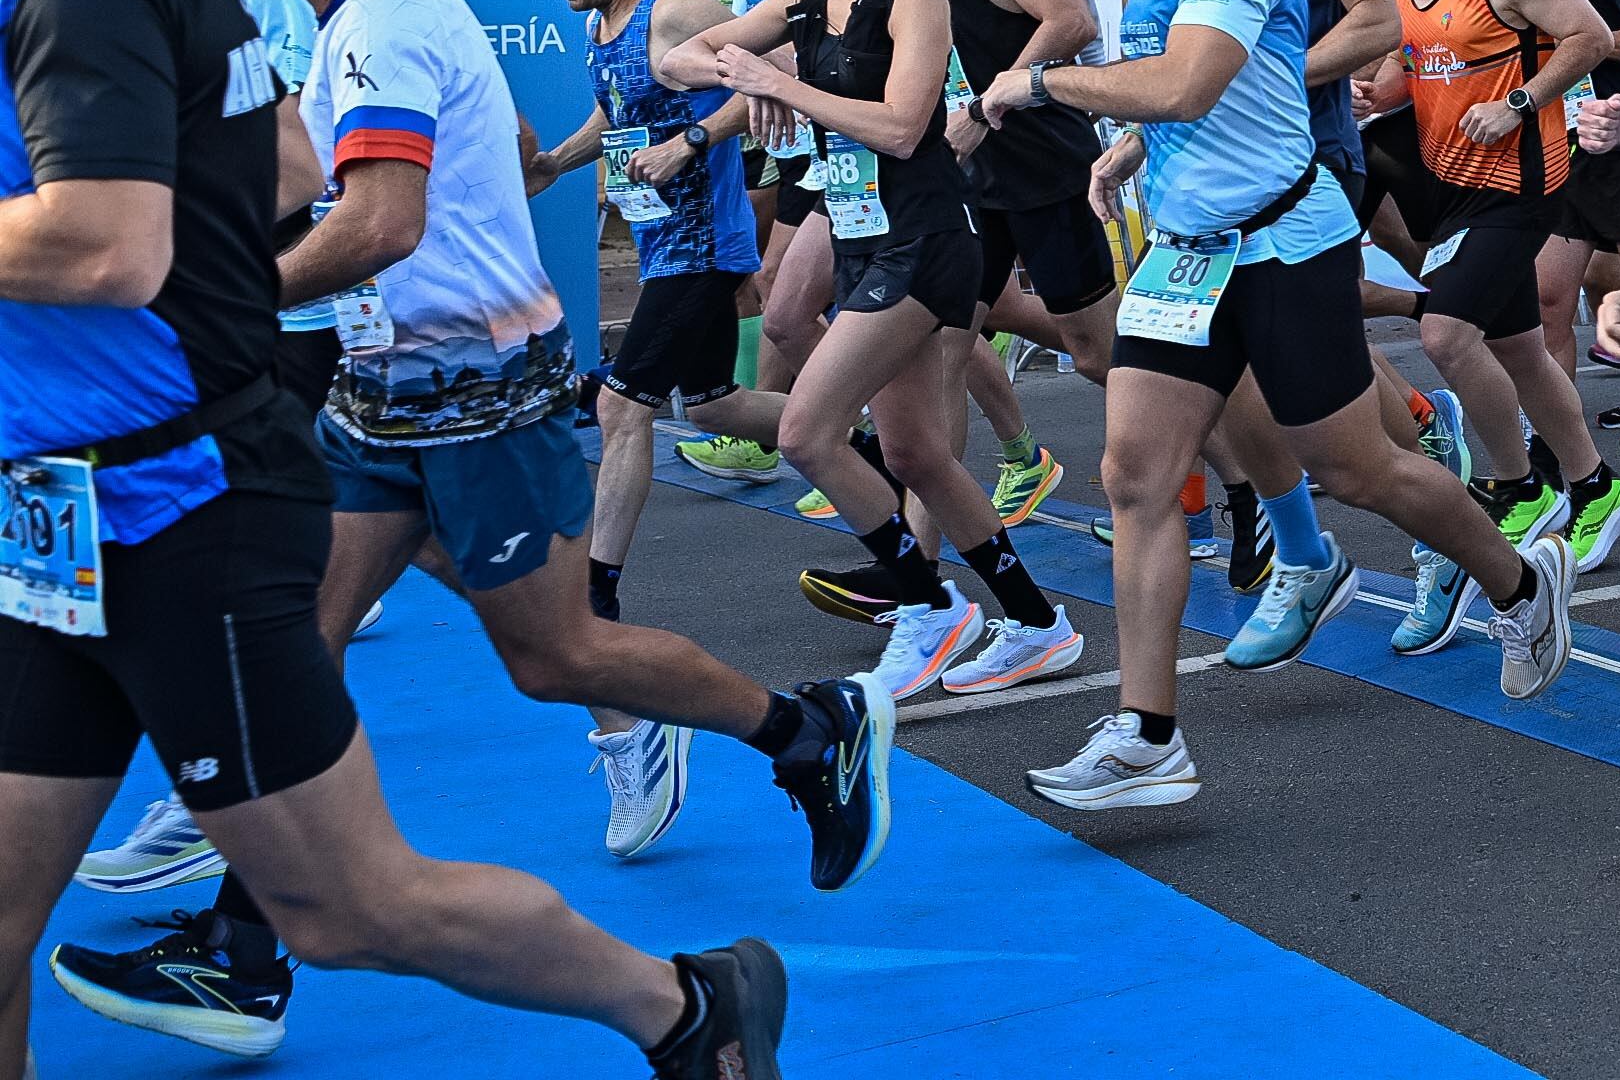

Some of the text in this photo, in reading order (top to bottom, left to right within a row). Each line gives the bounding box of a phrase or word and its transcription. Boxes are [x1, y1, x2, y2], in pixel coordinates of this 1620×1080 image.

[485, 16, 567, 56] ERÍA
[1167, 254, 1213, 287] 80
[606, 374, 627, 391] cep
